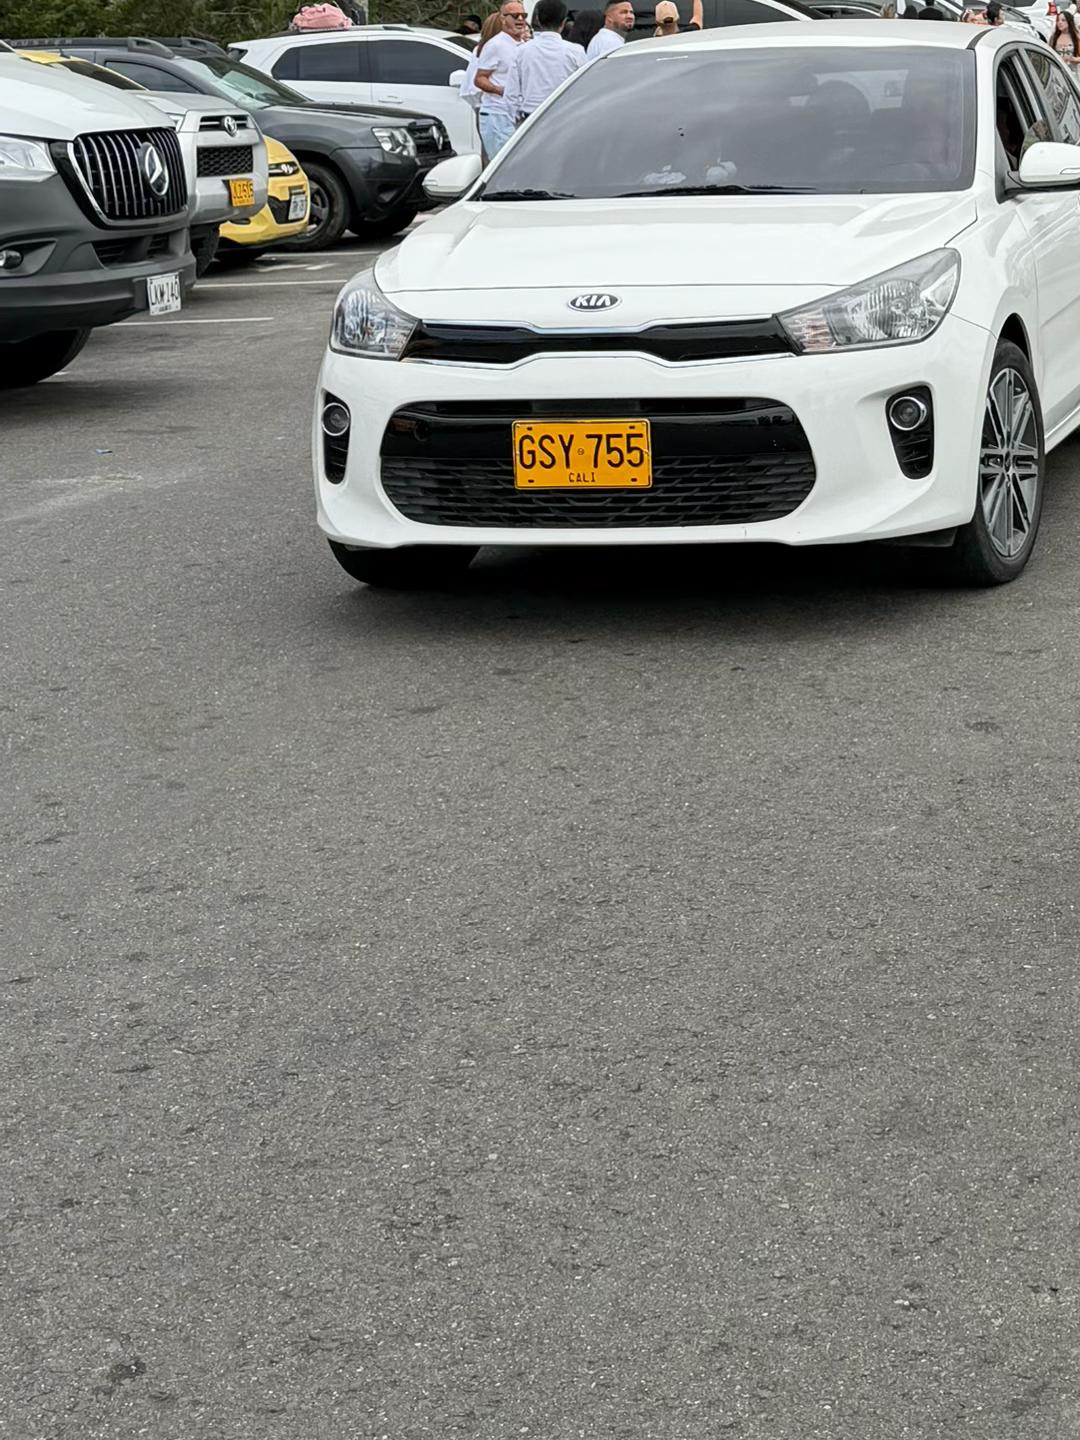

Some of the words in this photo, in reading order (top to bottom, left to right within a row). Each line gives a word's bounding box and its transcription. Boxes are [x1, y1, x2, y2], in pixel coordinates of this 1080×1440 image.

[575, 295, 611, 307] KIA
[518, 434, 575, 469] GSY
[585, 433, 645, 469] 755
[568, 472, 596, 483] CALI
